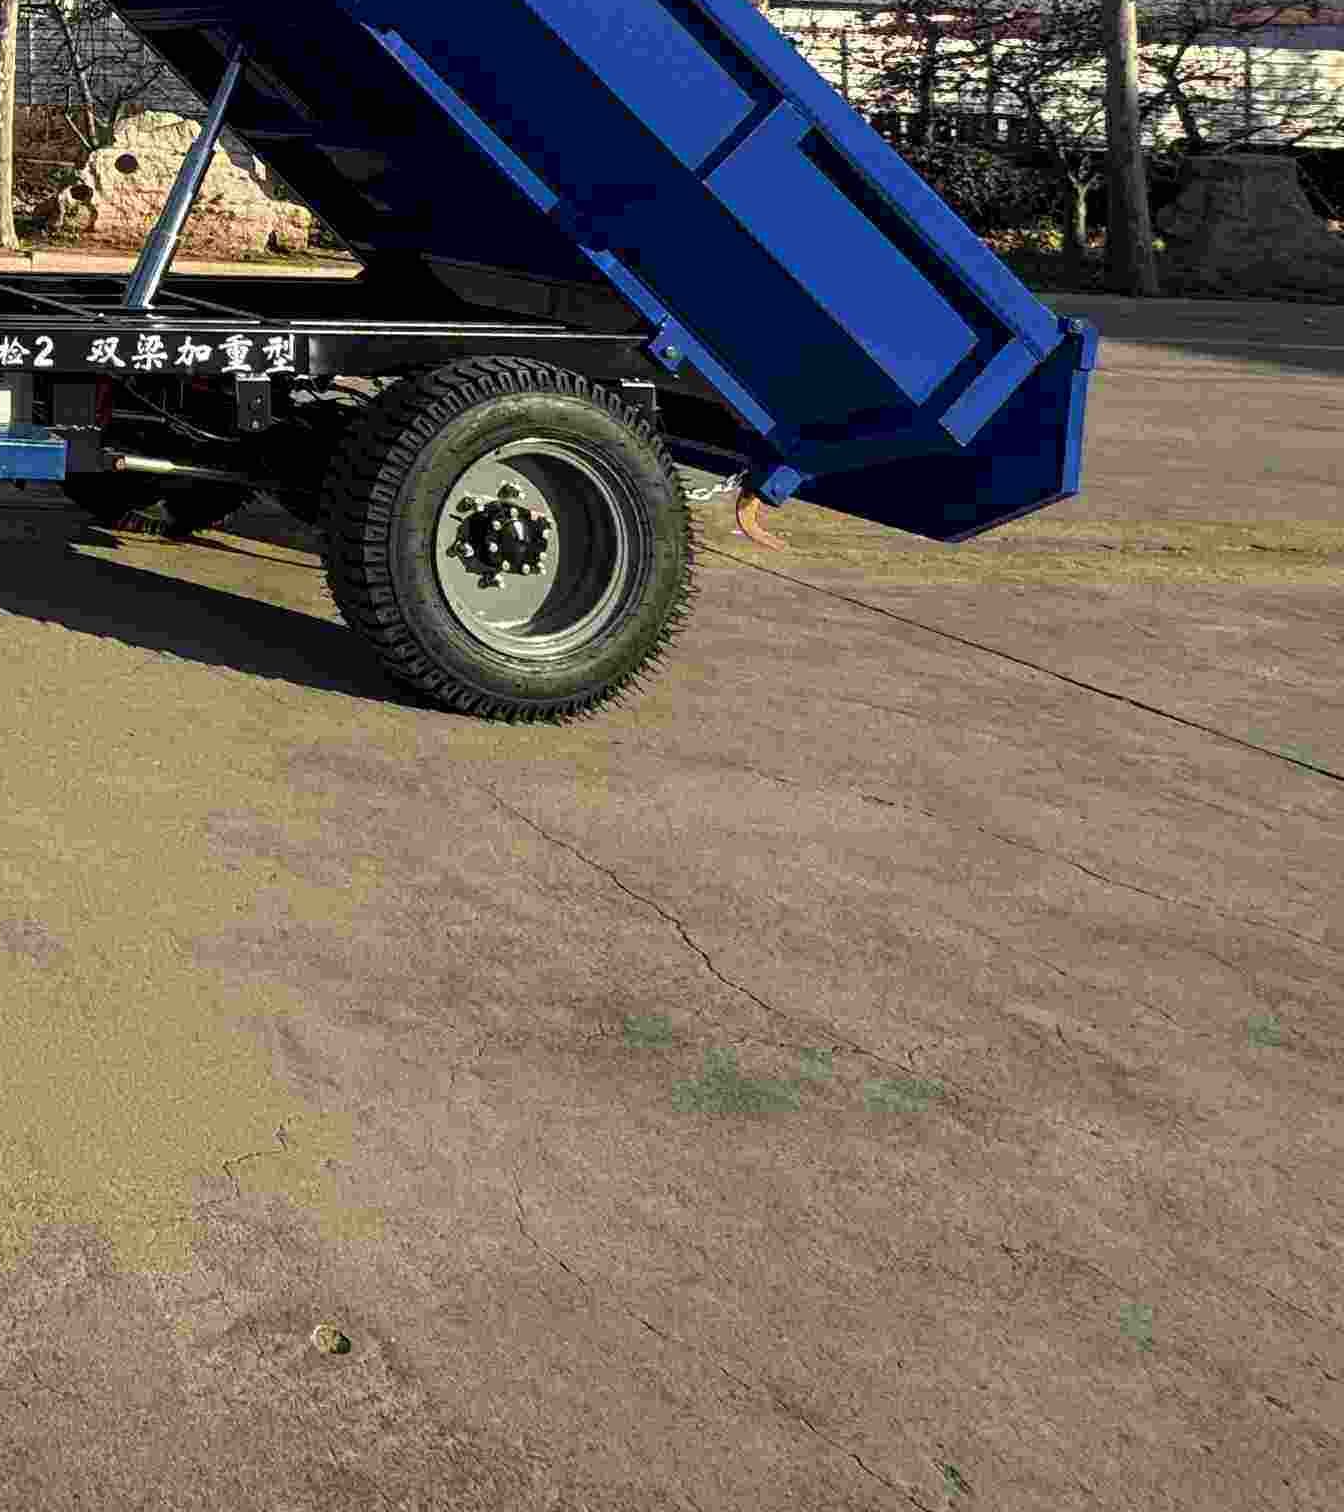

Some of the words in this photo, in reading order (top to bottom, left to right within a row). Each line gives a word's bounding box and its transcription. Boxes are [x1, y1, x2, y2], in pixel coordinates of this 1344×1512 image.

[85, 333, 296, 373] 双梁加重型
